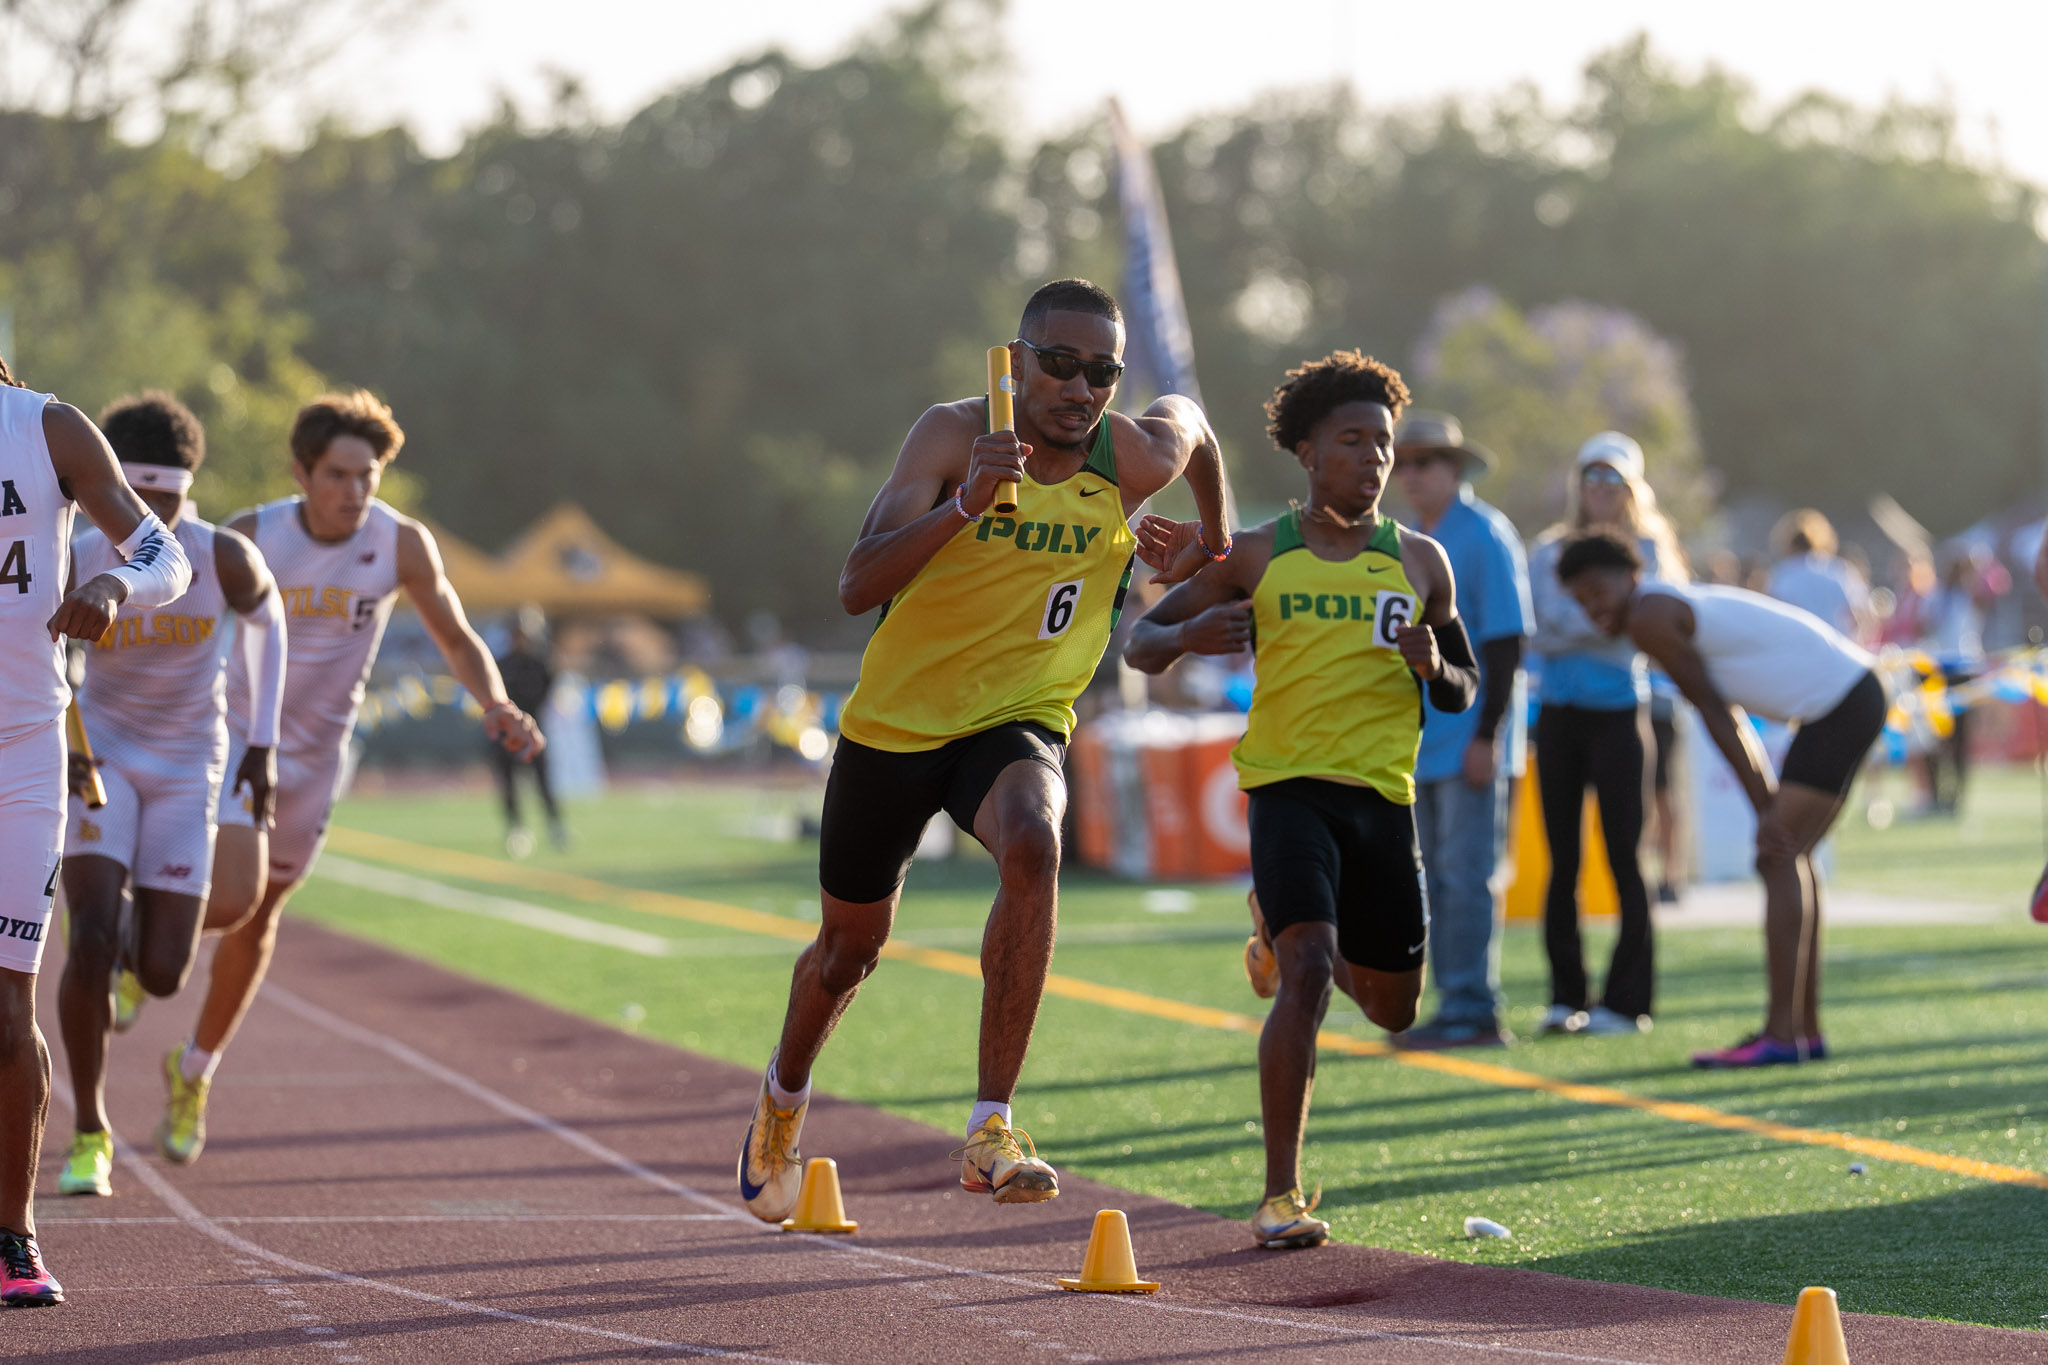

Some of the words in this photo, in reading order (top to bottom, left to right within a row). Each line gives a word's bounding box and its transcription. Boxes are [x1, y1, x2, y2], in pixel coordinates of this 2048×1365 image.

[0, 480, 27, 519] A
[976, 516, 1102, 554] POLY
[0, 540, 33, 594] 4
[353, 597, 379, 632] 5
[1047, 584, 1078, 634] 6
[1279, 592, 1377, 622] POL
[1381, 597, 1409, 644] 6
